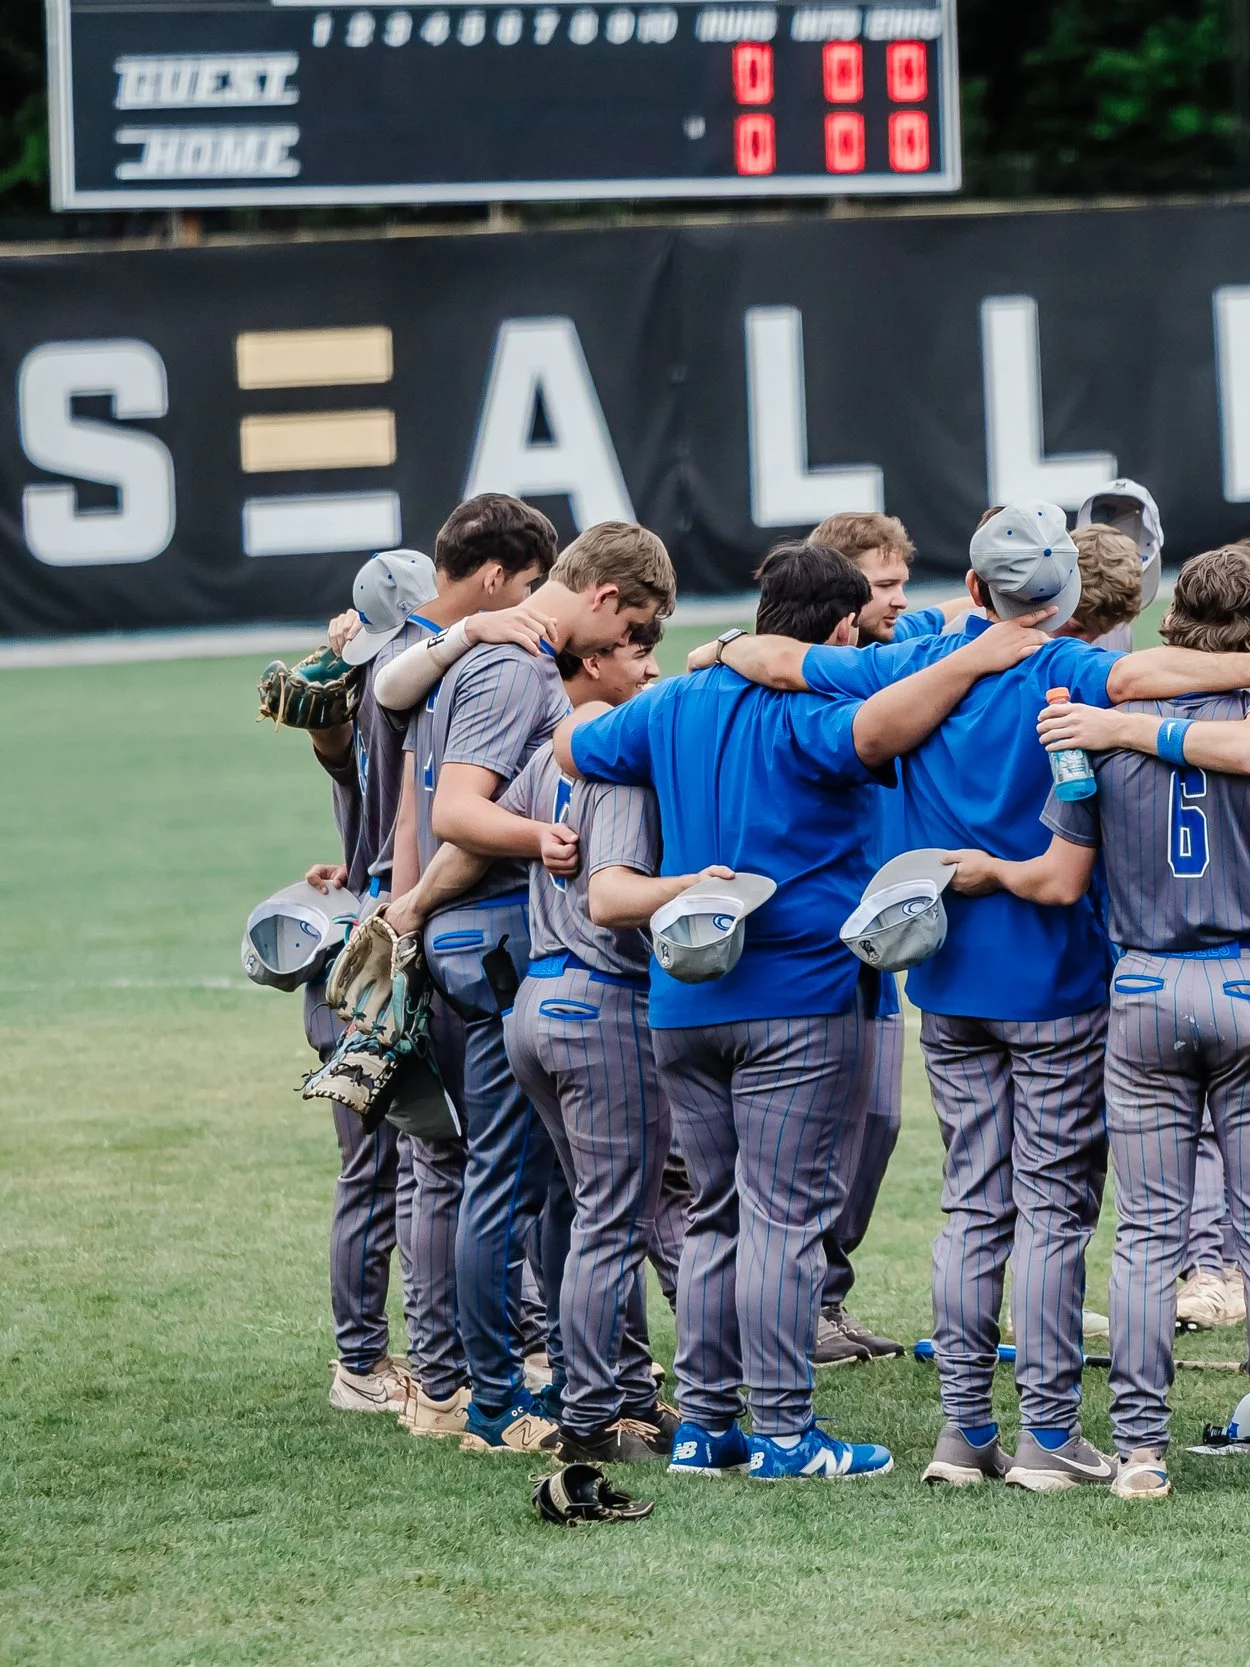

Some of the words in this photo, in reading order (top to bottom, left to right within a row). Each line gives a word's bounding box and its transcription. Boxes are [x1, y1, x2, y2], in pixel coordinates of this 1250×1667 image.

[313, 12, 332, 47] 1
[114, 53, 299, 109] GUEST
[732, 41, 775, 104] 0
[823, 40, 863, 103] 0
[886, 40, 927, 102] 0
[138, 127, 299, 179] HOME
[735, 113, 776, 175] 0
[825, 111, 865, 174] 0
[889, 111, 930, 173] 0
[1167, 767, 1210, 878] 6
